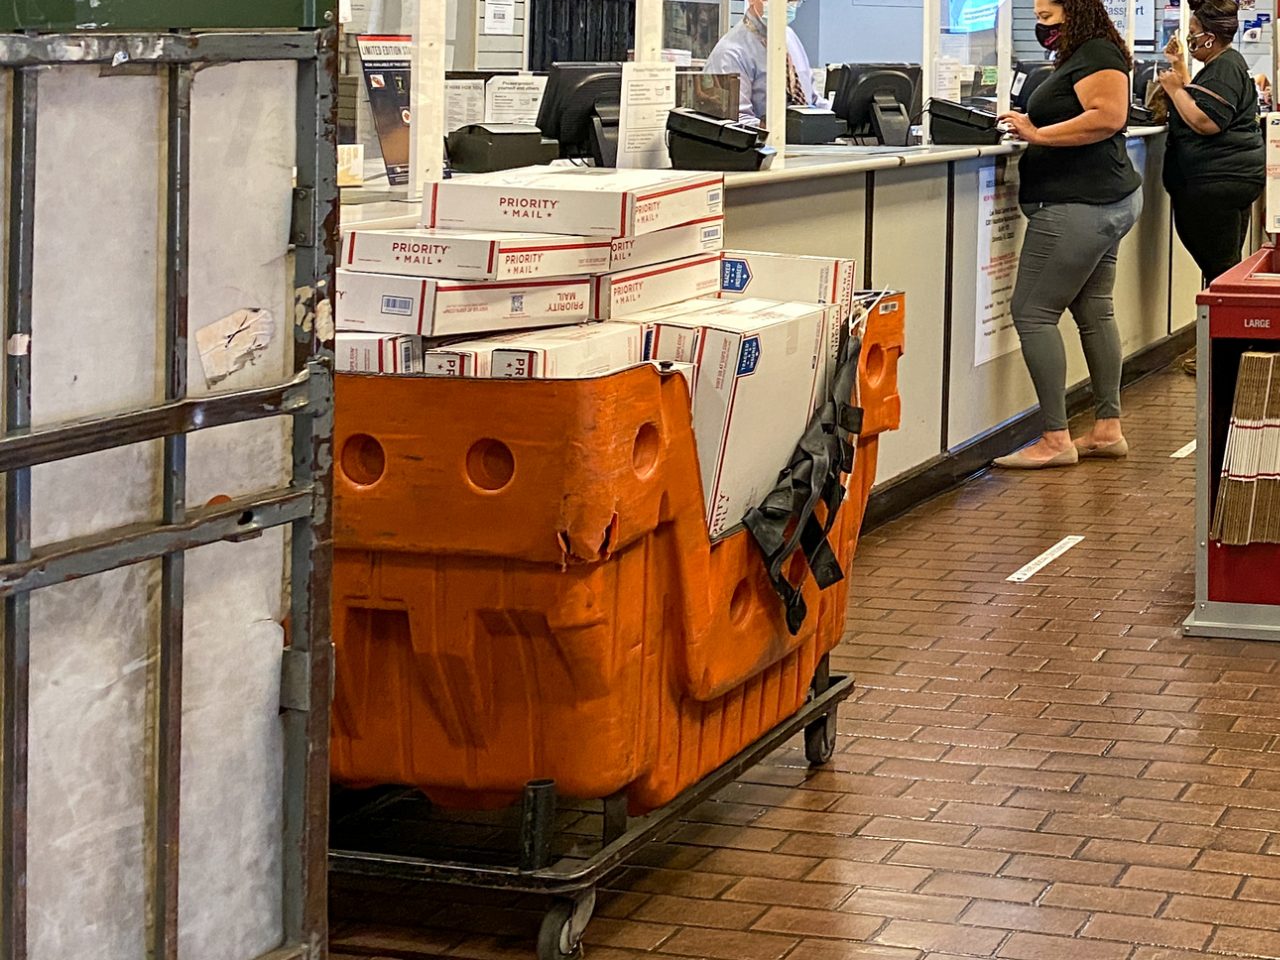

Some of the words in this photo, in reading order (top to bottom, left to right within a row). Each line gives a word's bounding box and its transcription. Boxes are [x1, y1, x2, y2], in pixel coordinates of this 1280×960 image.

[362, 45, 382, 56] LIMITED
[382, 45, 402, 56] EDITION
[499, 197, 559, 209] PRIORITY
[635, 201, 660, 213] PRIORITY
[512, 209, 543, 219] MAIL
[640, 214, 656, 223] MAIL
[392, 242, 449, 255] PRIORITY
[611, 240, 635, 252] ORITY
[404, 256, 433, 265] MAIL
[505, 253, 543, 265] PRIORITY
[613, 253, 627, 261] AIL
[513, 266, 532, 274] MAIL
[614, 281, 644, 296] PRIORITY
[844, 265, 852, 316] PRIORITY
[558, 292, 577, 301] MAIL
[620, 294, 636, 304] MAIL
[547, 300, 585, 310] PRIORITY
[1244, 319, 1270, 329] LARGE
